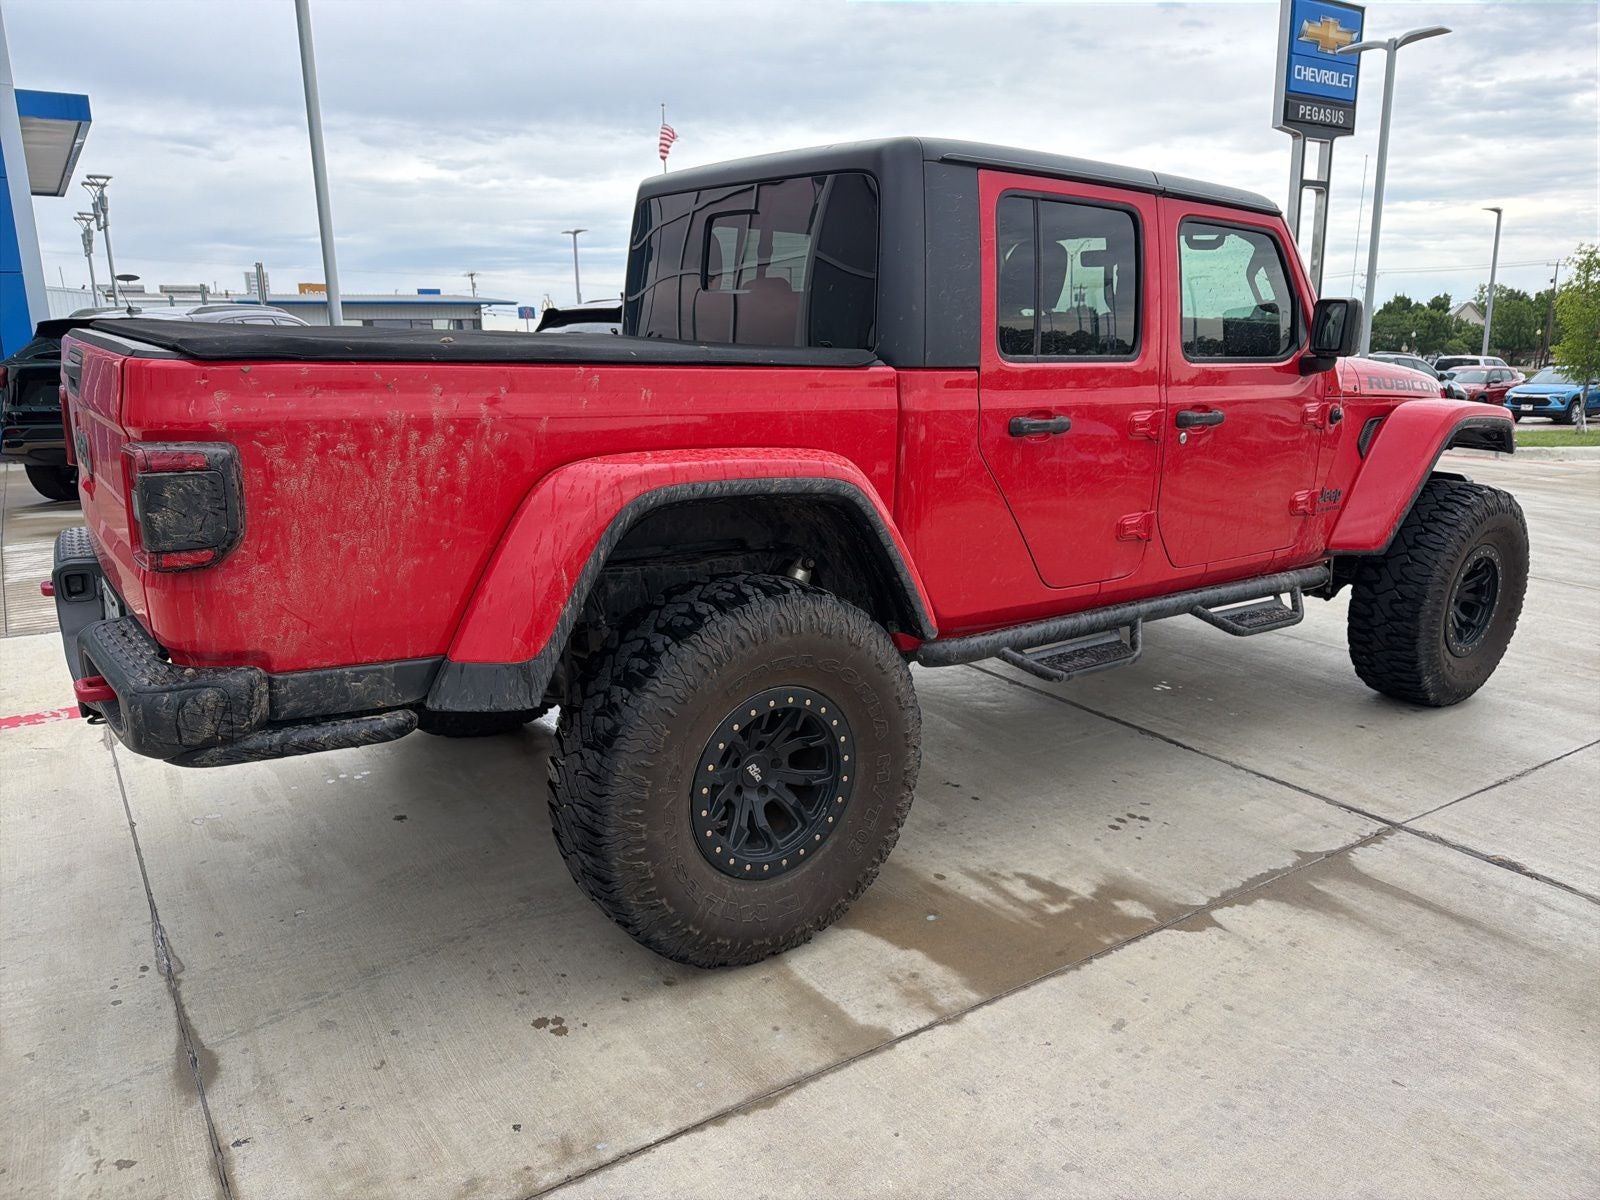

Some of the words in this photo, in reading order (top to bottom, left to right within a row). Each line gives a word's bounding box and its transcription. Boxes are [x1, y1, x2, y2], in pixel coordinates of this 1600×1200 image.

[1294, 64, 1355, 88] CHEVROLET
[1298, 105, 1345, 124] PEGASUS
[1367, 375, 1440, 393] RUBICON
